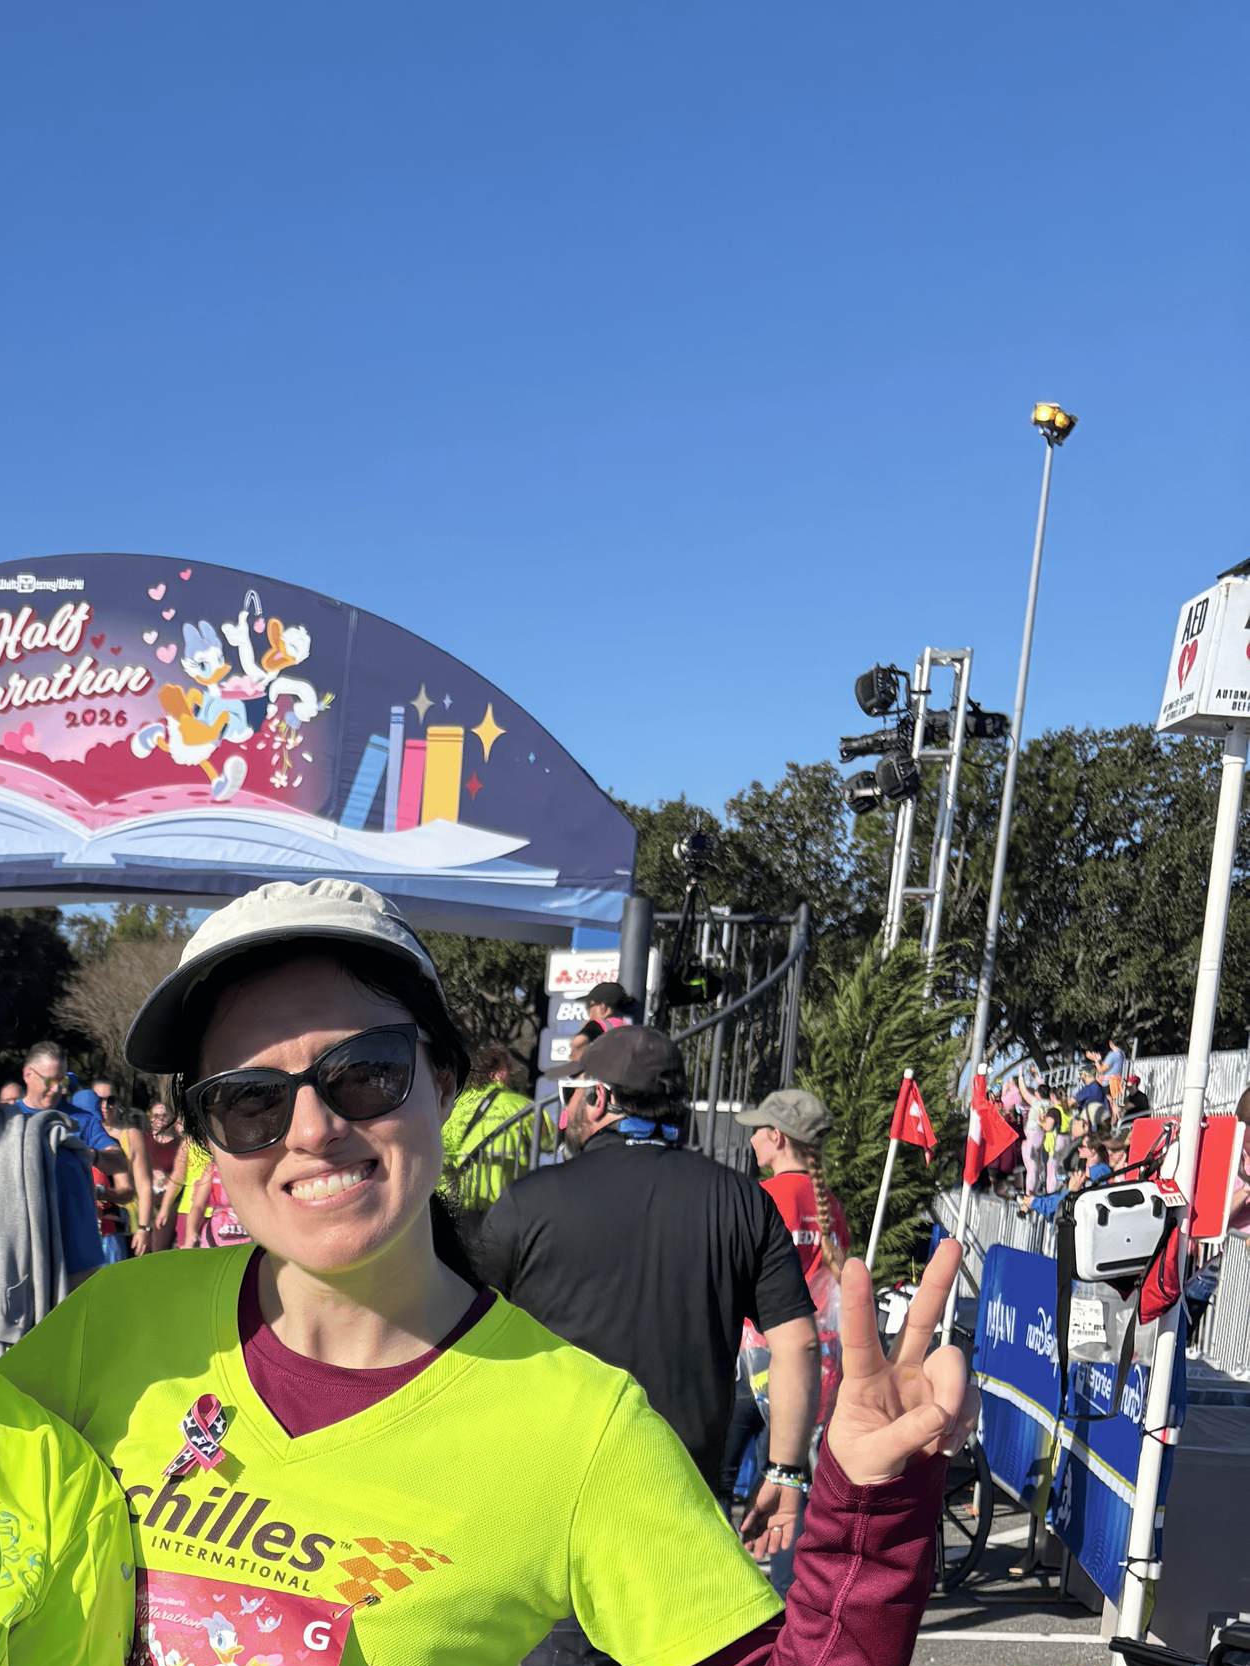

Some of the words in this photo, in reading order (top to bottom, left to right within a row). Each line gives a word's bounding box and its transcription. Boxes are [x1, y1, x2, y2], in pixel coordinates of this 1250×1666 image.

[1181, 597, 1209, 645] AED
[65, 708, 128, 728] 2026
[1165, 1195, 1184, 1205] 911
[111, 1467, 336, 1573] chilles
[151, 1536, 312, 1593] INTERNATIONAL
[140, 1604, 203, 1629] Marathon
[302, 1621, 332, 1651] G
